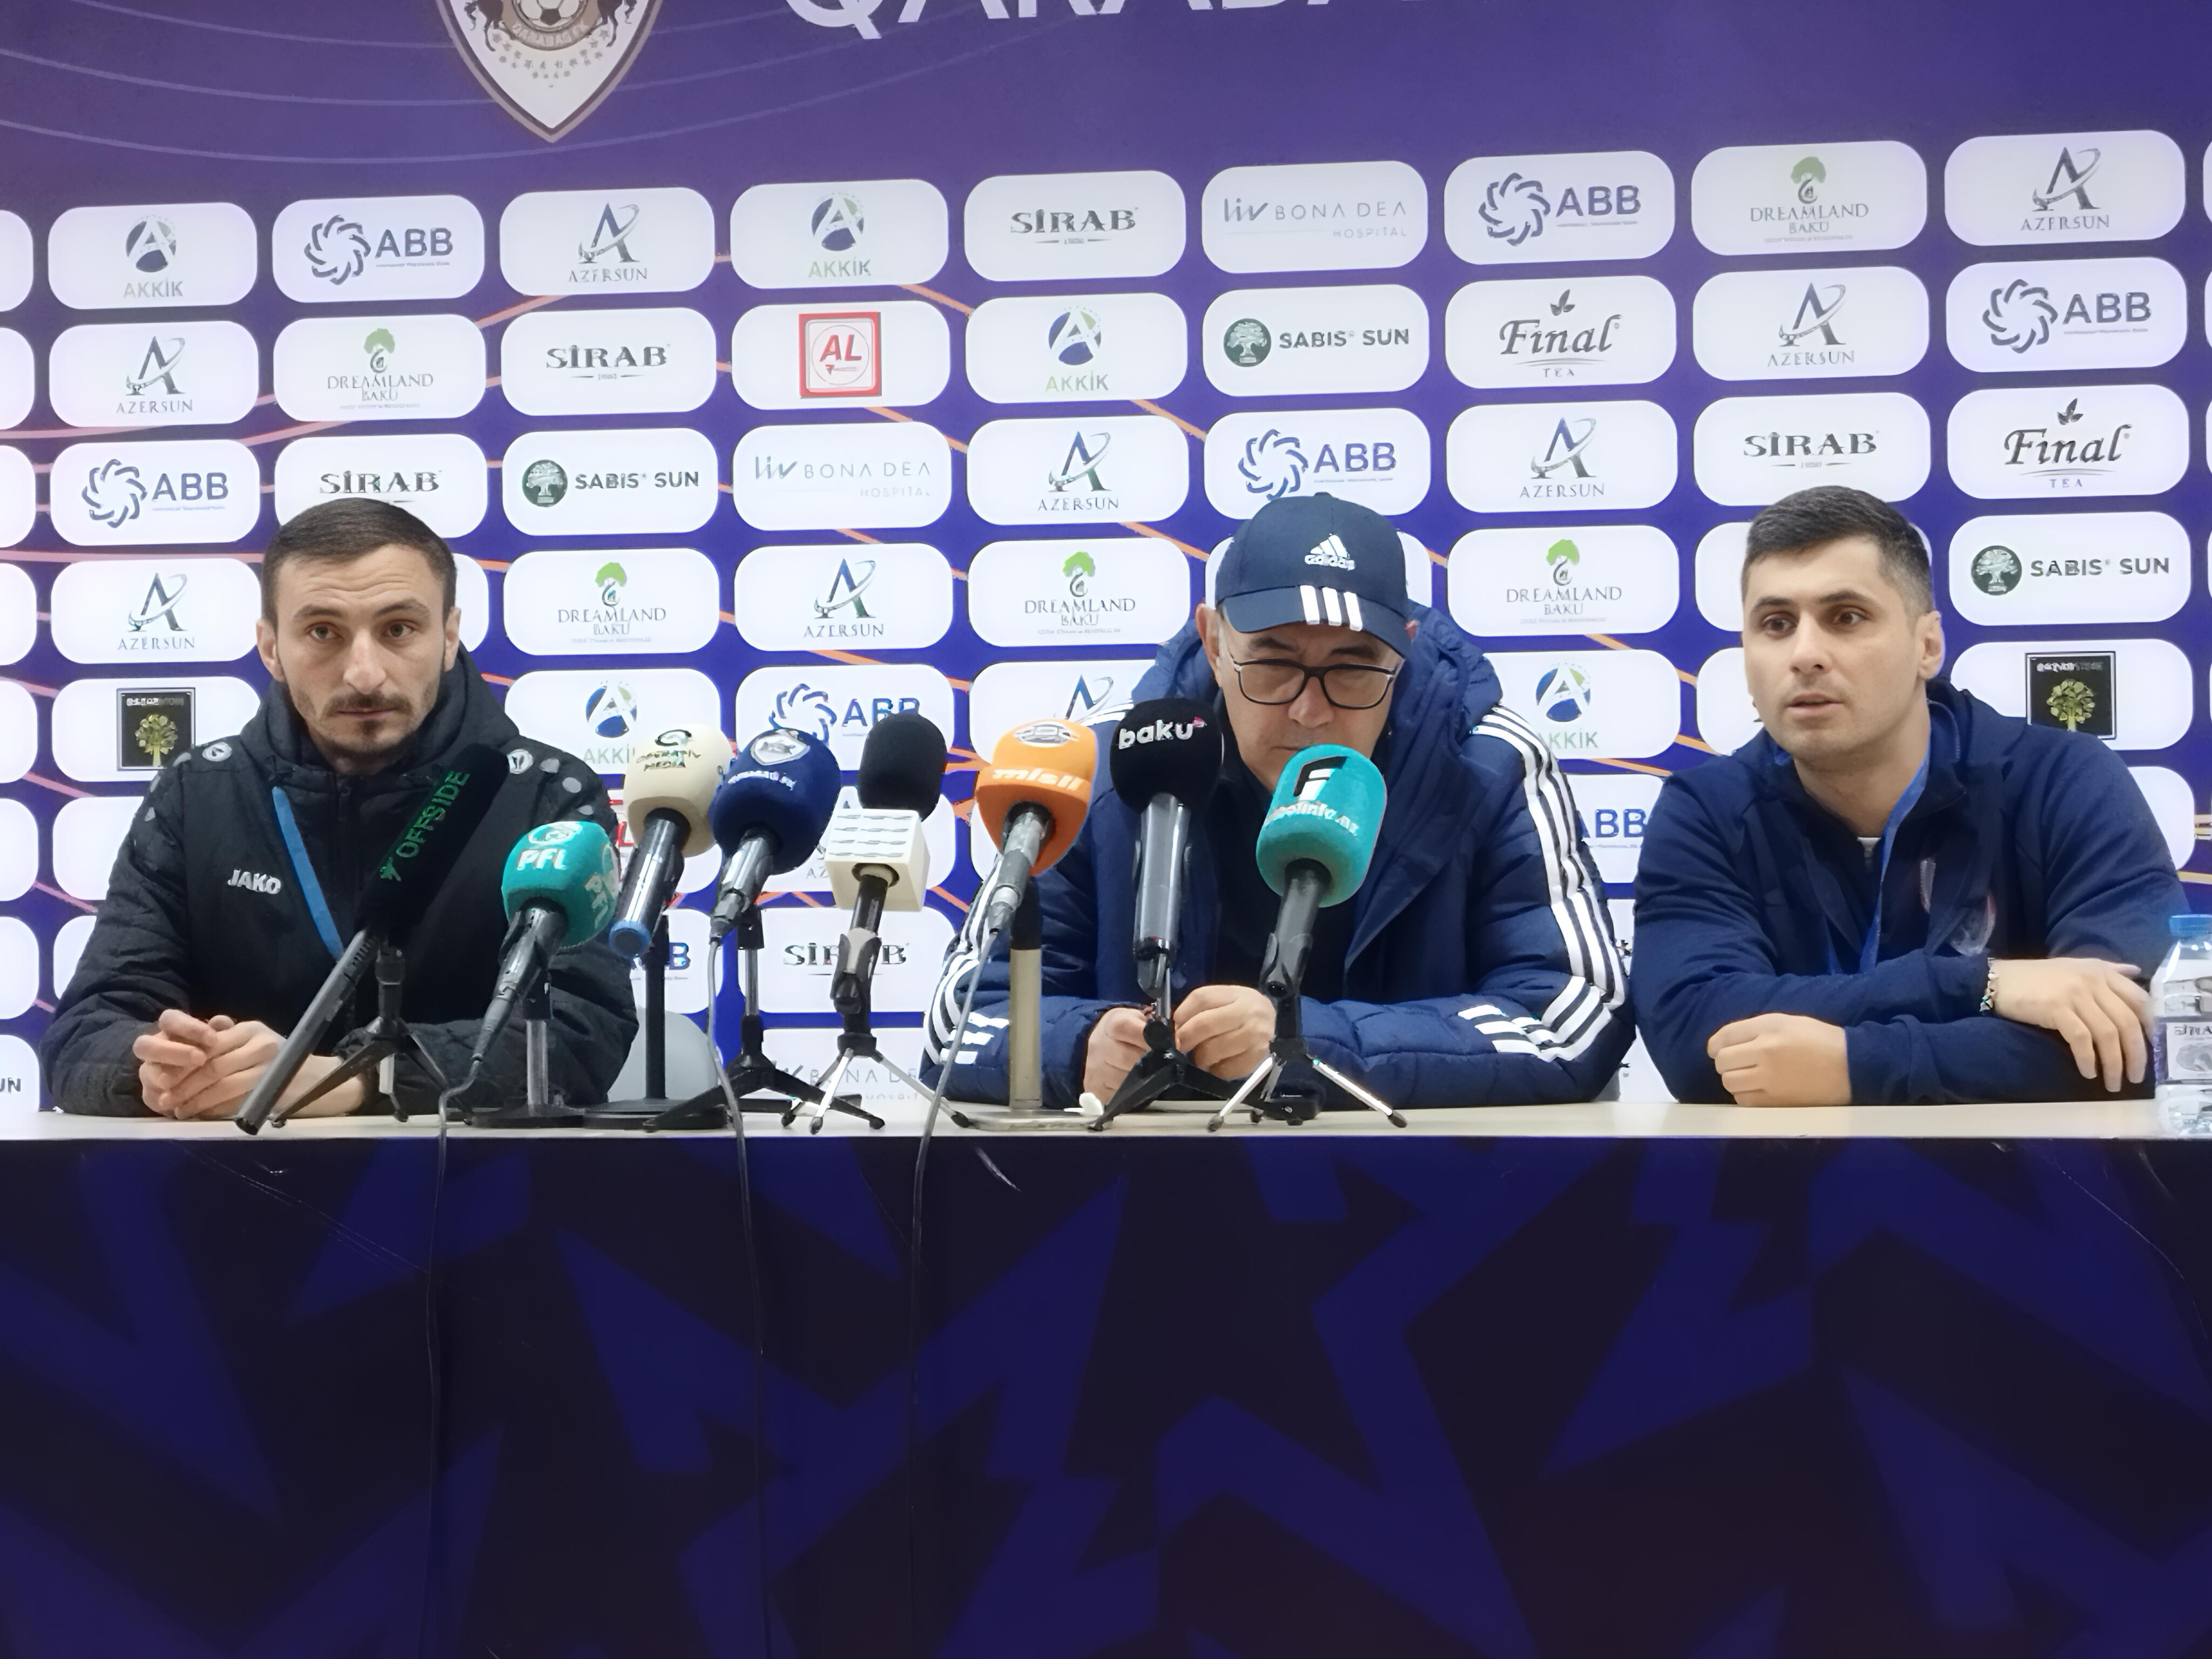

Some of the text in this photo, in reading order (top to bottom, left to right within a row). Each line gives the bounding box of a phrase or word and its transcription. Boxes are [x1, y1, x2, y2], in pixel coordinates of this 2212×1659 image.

[1276, 203, 1344, 220] BONA
[1358, 201, 1406, 217] DEA
[1556, 185, 1641, 218] ABB
[1011, 209, 1136, 233] SİRAB
[1751, 203, 1869, 222] DREAMLAND
[1333, 227, 1406, 238] HOSPITAL
[2021, 215, 2109, 231] AZERSUN
[375, 227, 453, 258] ABB
[569, 268, 648, 282] AZERSUN
[808, 257, 871, 278] AKKİK
[124, 278, 183, 298] AKKİK
[2062, 292, 2152, 325] ABB
[1363, 329, 1409, 346] SUN
[1499, 314, 1622, 355] Final
[547, 345, 667, 368] SİRAB
[819, 334, 863, 363] AL
[1768, 350, 1854, 366] AZERSUN
[328, 374, 434, 390] DREAMLAND
[1046, 370, 1109, 392] AKKİK
[1543, 368, 1575, 377] TEA
[117, 400, 193, 414] AZERSUN
[1744, 431, 1876, 457] SİRAB
[2004, 423, 2132, 465] Final
[1313, 442, 1397, 473] ABB
[655, 471, 699, 488] SUN
[804, 463, 872, 478] BONA
[884, 462, 930, 476] DEA
[152, 472, 228, 501] ABB
[320, 470, 439, 494] SİRAB
[1520, 483, 1604, 498] AZERSUN
[2049, 478, 2083, 489] TEA
[1038, 497, 1118, 511] AZERSUN
[1305, 554, 1355, 571] adidas
[2120, 557, 2169, 575] SUN
[1507, 586, 1622, 603] DREAMLAND
[1024, 597, 1136, 613] DREAMLAND
[558, 607, 666, 623] DREAMLAND
[804, 624, 884, 638] AZERSUN
[118, 637, 194, 650] AZERSUN
[1118, 719, 1194, 750] baku
[583, 744, 636, 765] AKKİ
[396, 770, 470, 858] OFFSIDE
[516, 848, 567, 871] PFL
[227, 869, 282, 895] JAKO
[784, 942, 907, 966] SİRB
[811, 1068, 878, 1084] BNA
